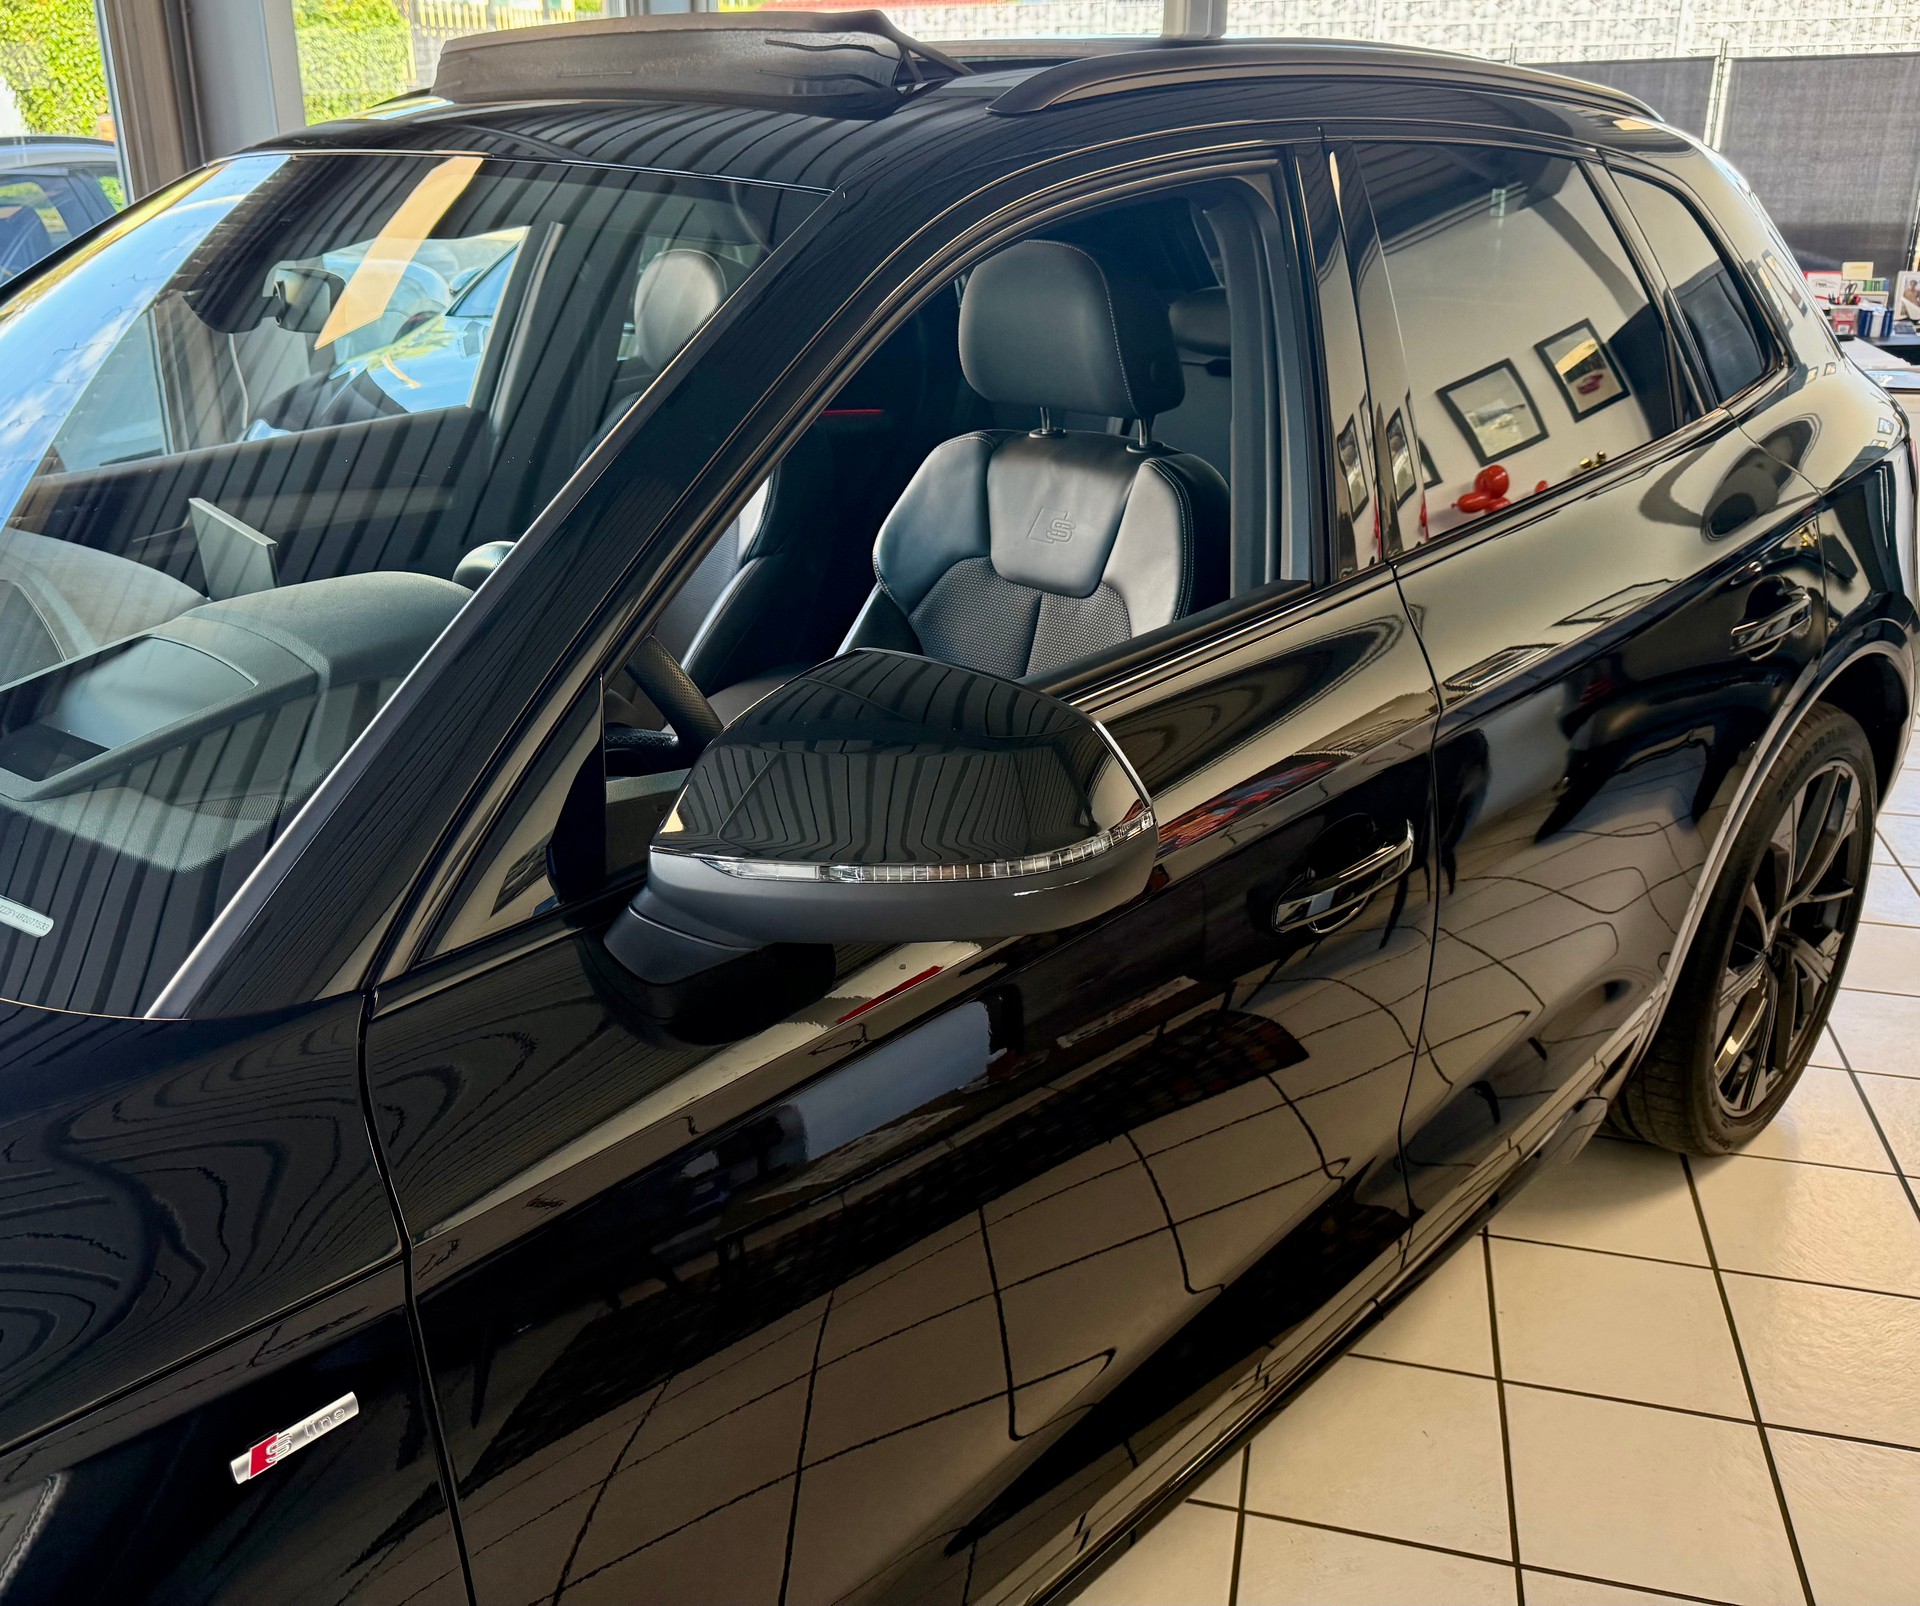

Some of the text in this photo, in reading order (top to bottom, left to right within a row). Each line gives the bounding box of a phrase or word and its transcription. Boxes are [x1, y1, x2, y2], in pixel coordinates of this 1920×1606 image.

[1045, 517, 1076, 543] S
[265, 1407, 346, 1464] S line
